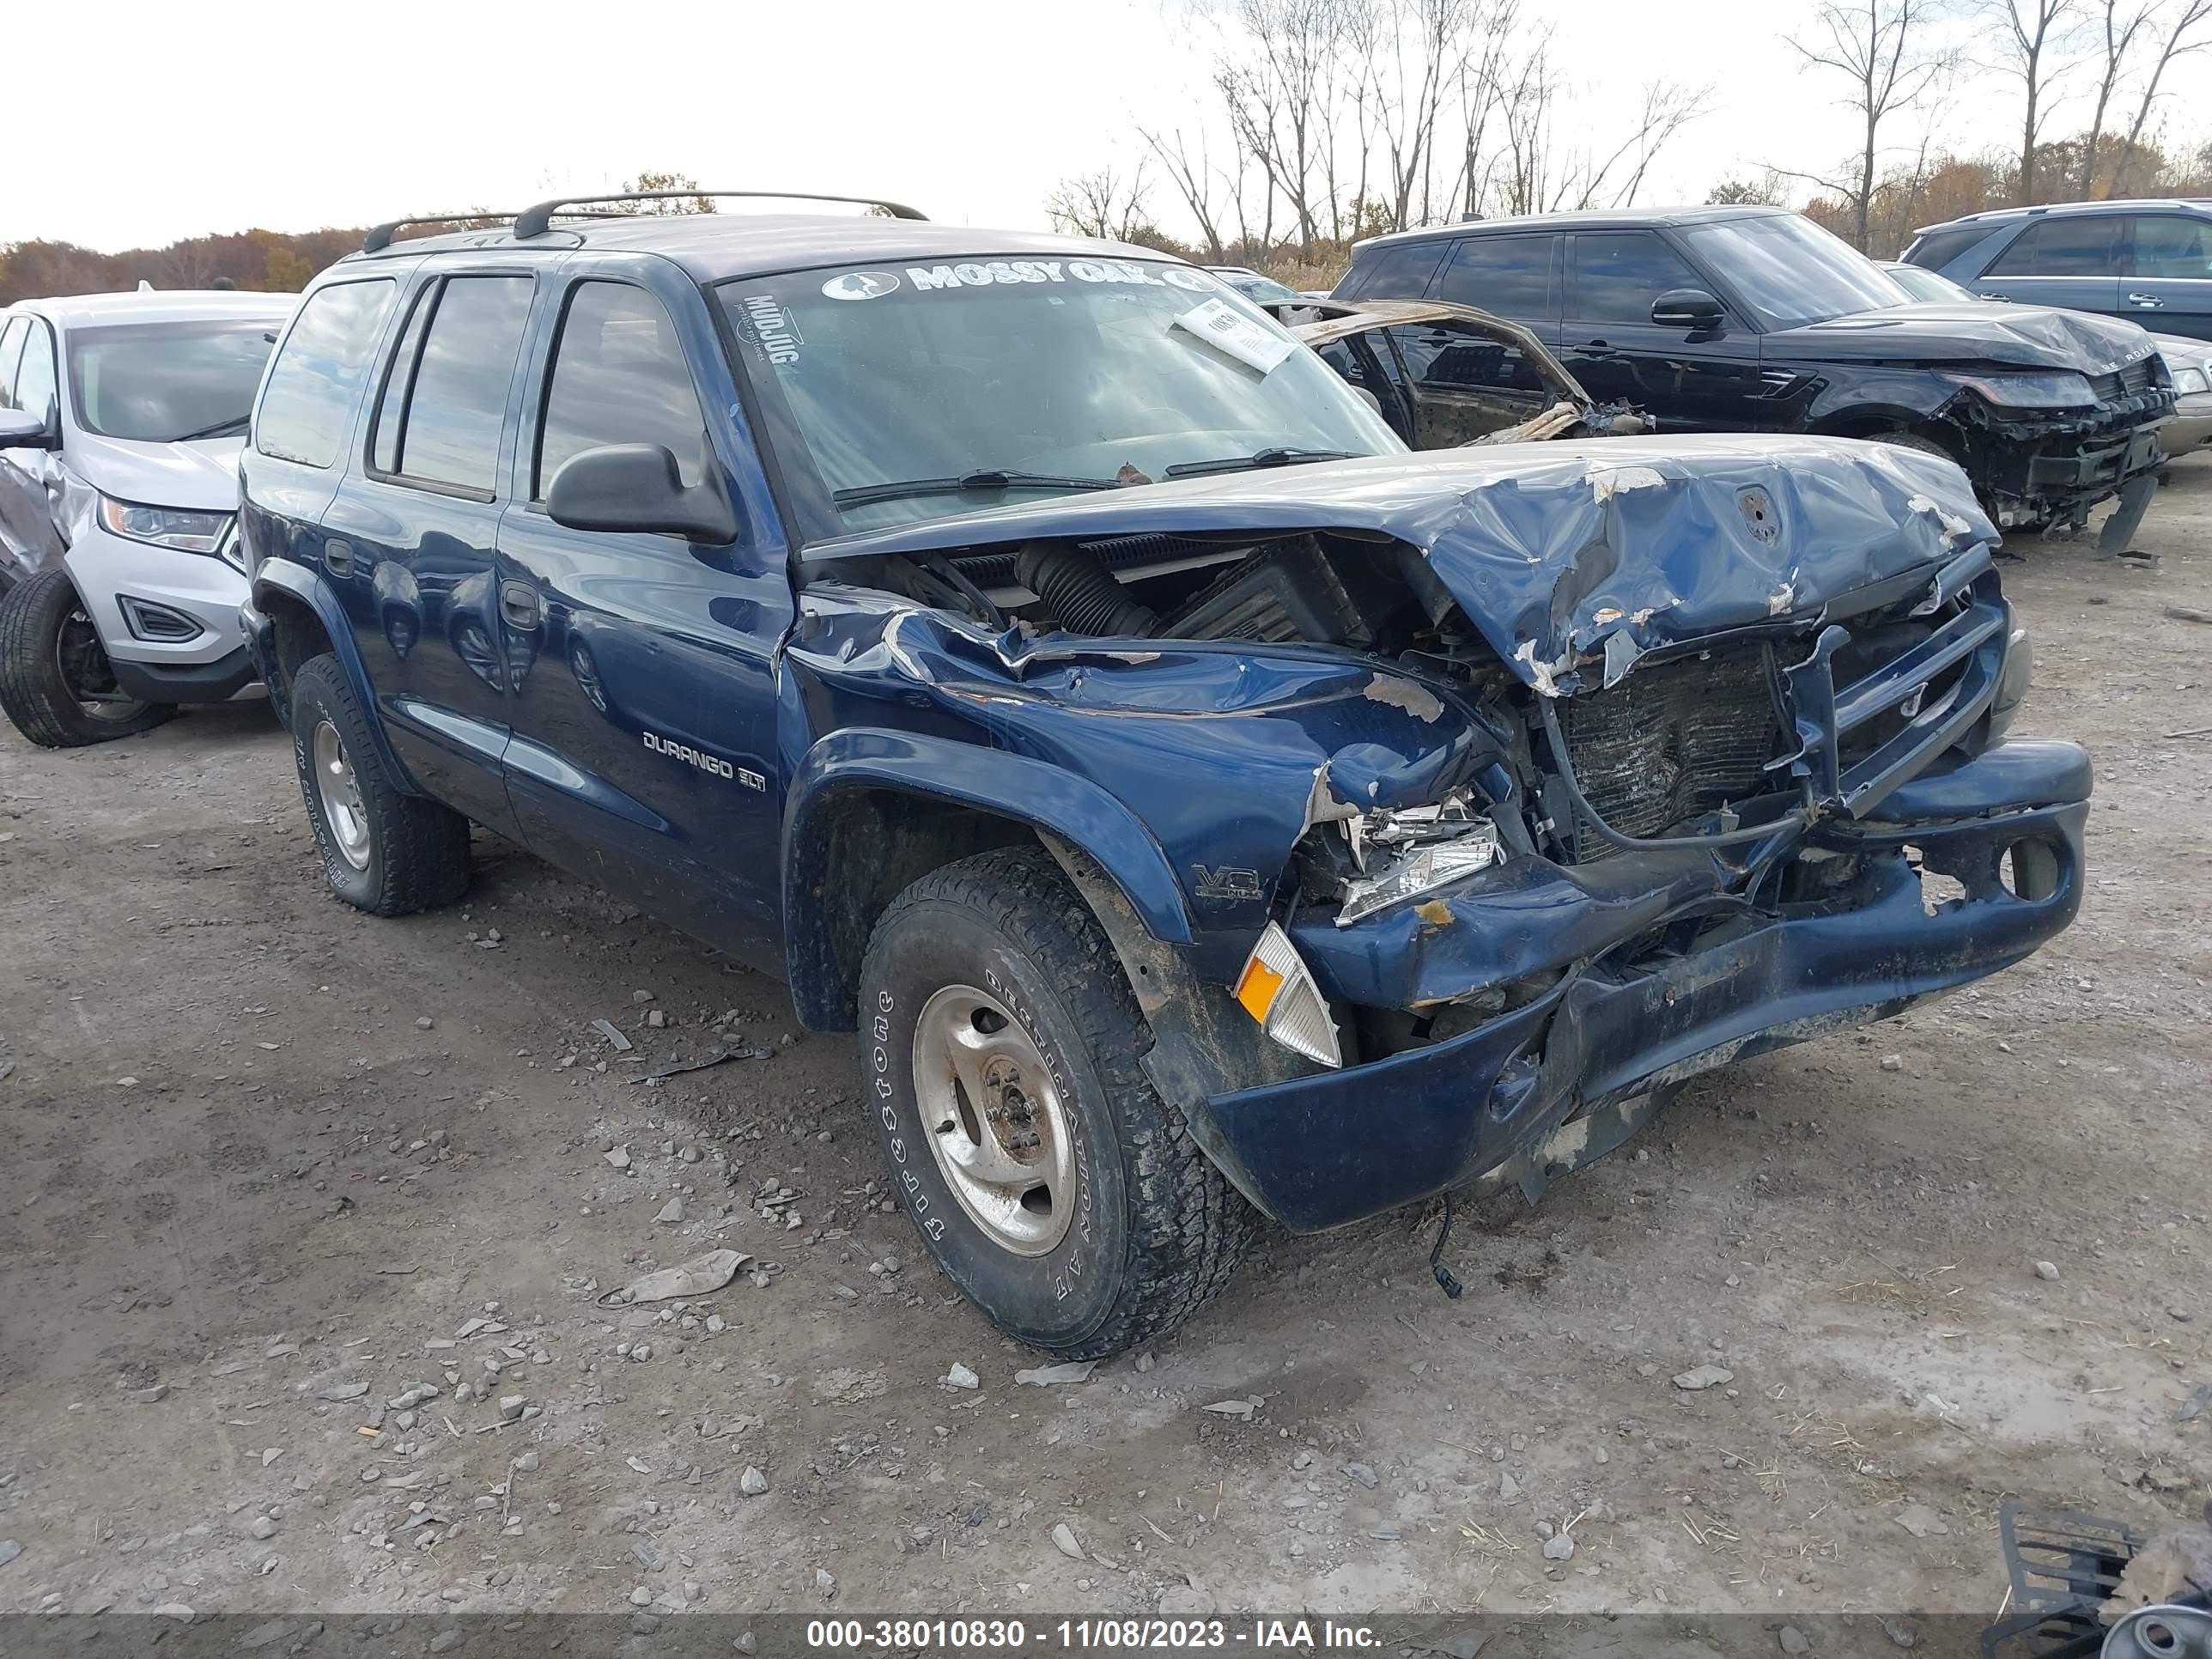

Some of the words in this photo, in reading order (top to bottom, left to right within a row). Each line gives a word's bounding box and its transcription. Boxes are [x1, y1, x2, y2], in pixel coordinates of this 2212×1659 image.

[905, 261, 1066, 291] MOSSY
[1068, 261, 1165, 286] OAK
[1208, 312, 1241, 334] 10830
[642, 731, 733, 779] DURANGO
[739, 770, 763, 790] SLT
[985, 968, 1092, 1244] DESTINATION
